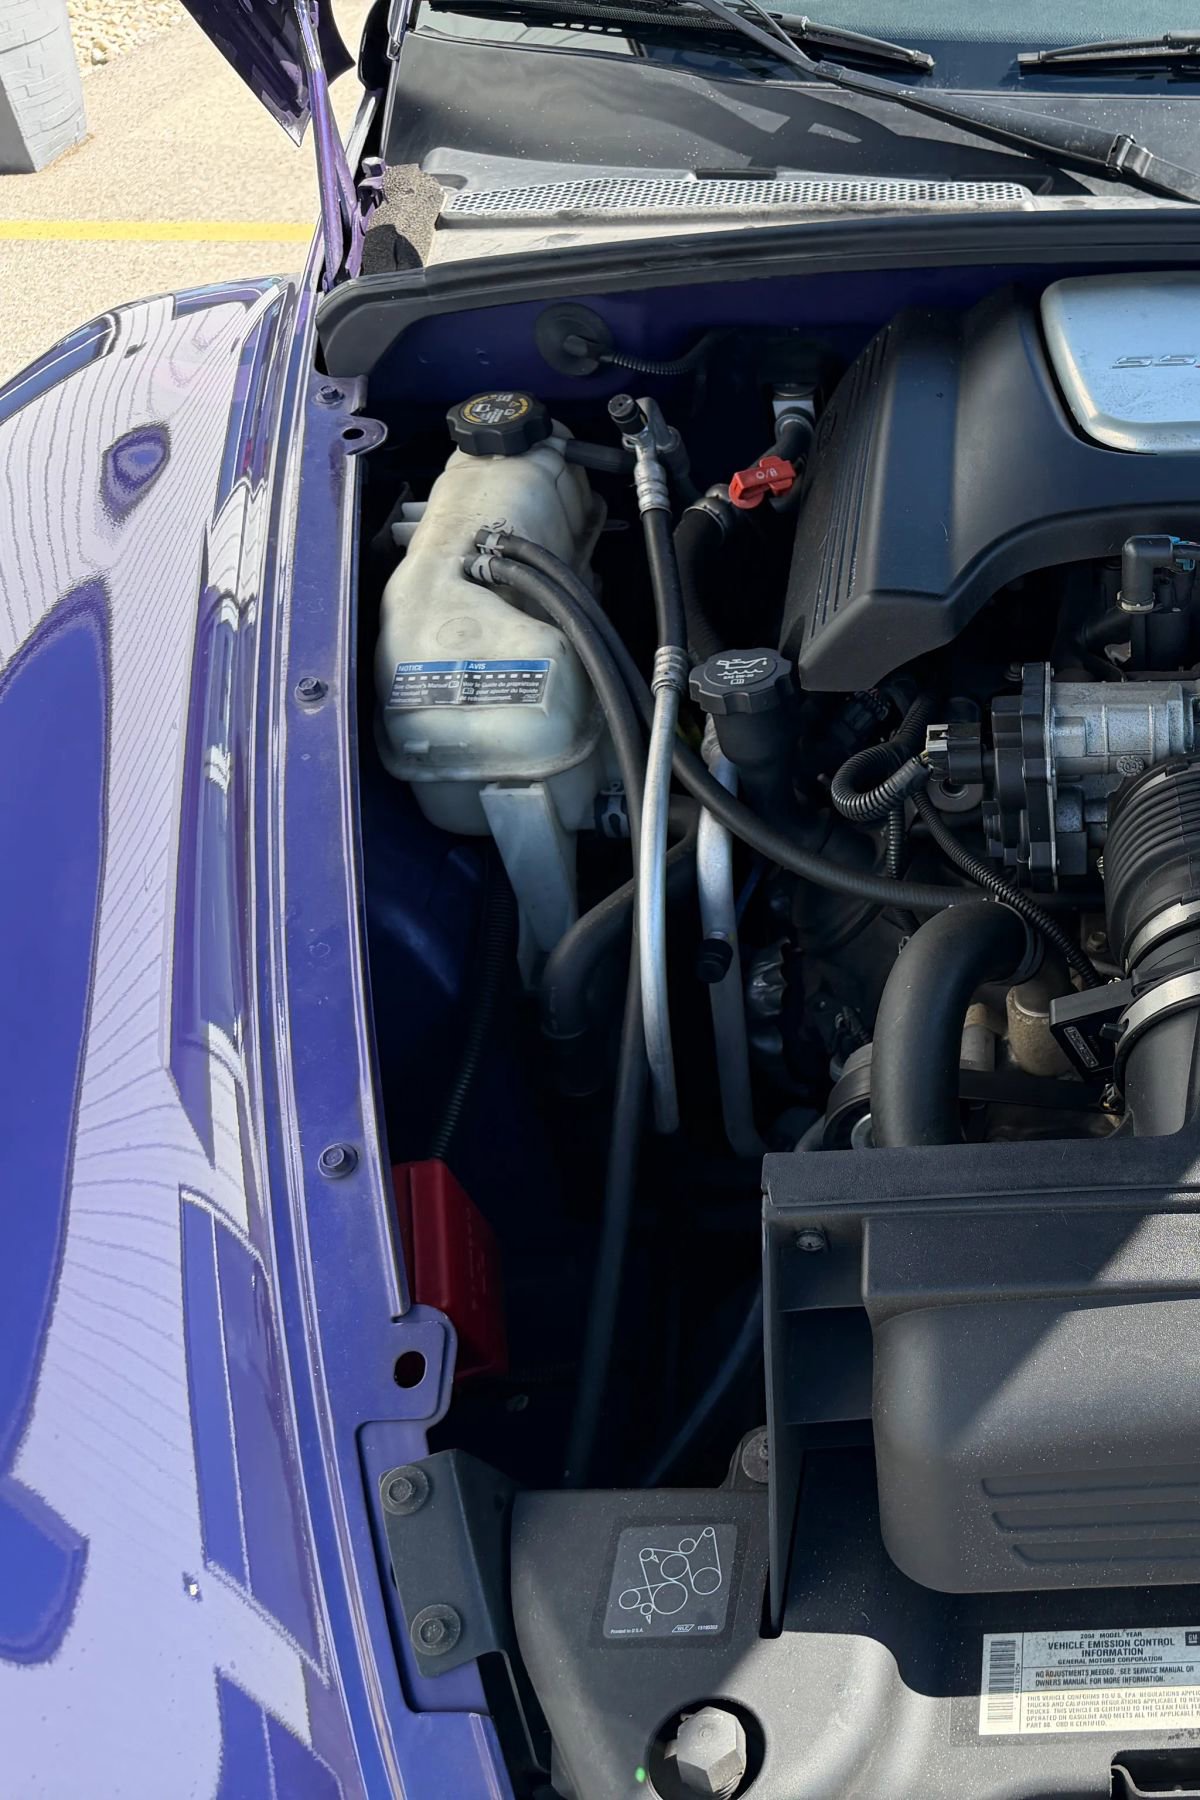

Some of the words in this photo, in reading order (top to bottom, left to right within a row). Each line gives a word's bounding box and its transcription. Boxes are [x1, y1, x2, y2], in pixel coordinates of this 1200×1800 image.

[1048, 1640, 1085, 1650] VEHICLE
[1088, 1639, 1131, 1649] EMISSION
[1134, 1637, 1175, 1647] CONTROL
[1081, 1647, 1144, 1658] INFORMATION
[1035, 1671, 1044, 1679] NO
[1045, 1669, 1089, 1678] ADJUSTMENTS
[1090, 1668, 1116, 1676] NEEDED.
[1132, 1667, 1158, 1675] SERVICE
[1159, 1666, 1184, 1674] MANUAL
[1185, 1665, 1194, 1673] OR
[1035, 1679, 1061, 1687] OWNERS
[1062, 1678, 1088, 1686] MANUAL
[1089, 1677, 1102, 1685] FOR
[1103, 1677, 1121, 1685] MORE
[1122, 1675, 1165, 1684] INFORMATION.
